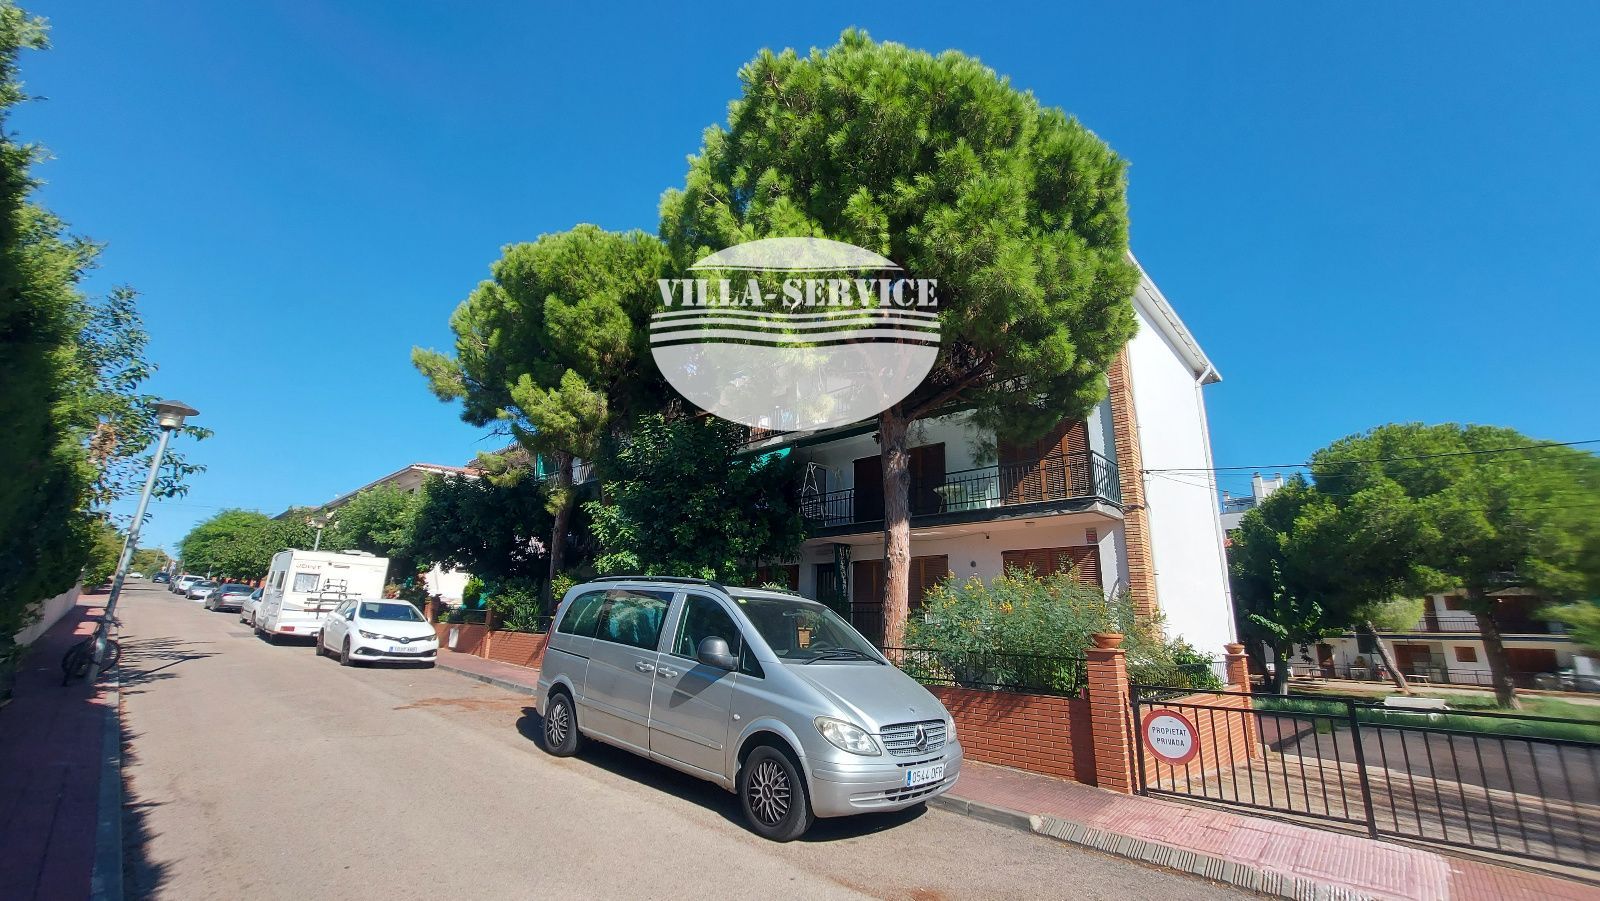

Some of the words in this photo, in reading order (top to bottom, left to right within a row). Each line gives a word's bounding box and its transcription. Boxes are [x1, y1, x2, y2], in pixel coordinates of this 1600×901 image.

[1152, 726, 1187, 737] PROPIETAT
[1156, 737, 1185, 747] PRIVADA
[912, 769, 930, 783] 0544
